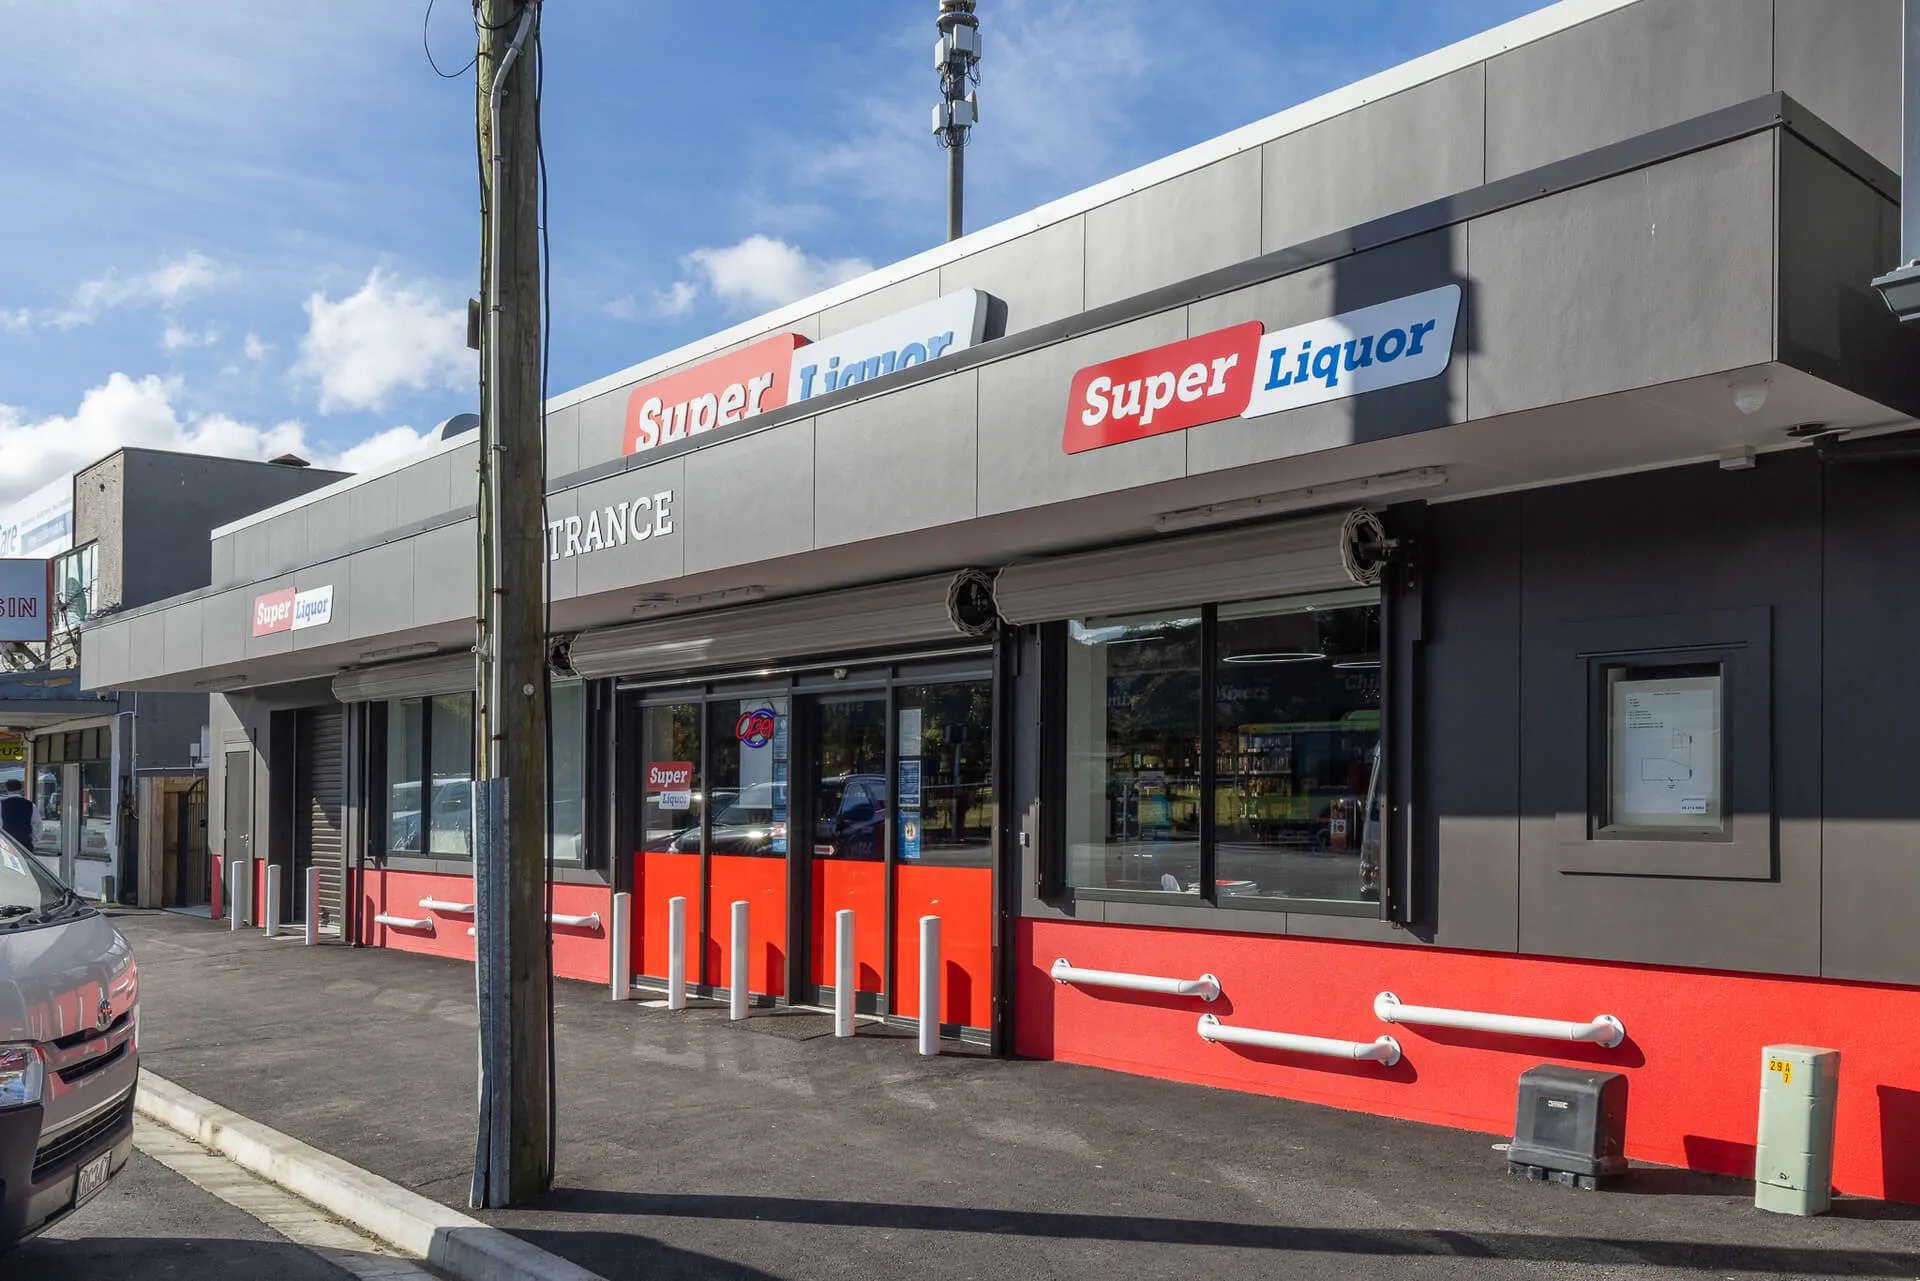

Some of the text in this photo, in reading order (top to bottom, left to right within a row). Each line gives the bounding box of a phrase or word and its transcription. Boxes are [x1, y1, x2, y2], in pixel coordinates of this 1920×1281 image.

[1082, 319, 1435, 426] Super Liquor
[636, 372, 773, 452] Super
[0, 525, 17, 552] are
[546, 490, 674, 561] TRANCE
[257, 599, 328, 628] Super Liquor
[650, 767, 688, 788] Super
[663, 793, 687, 806] Liquor
